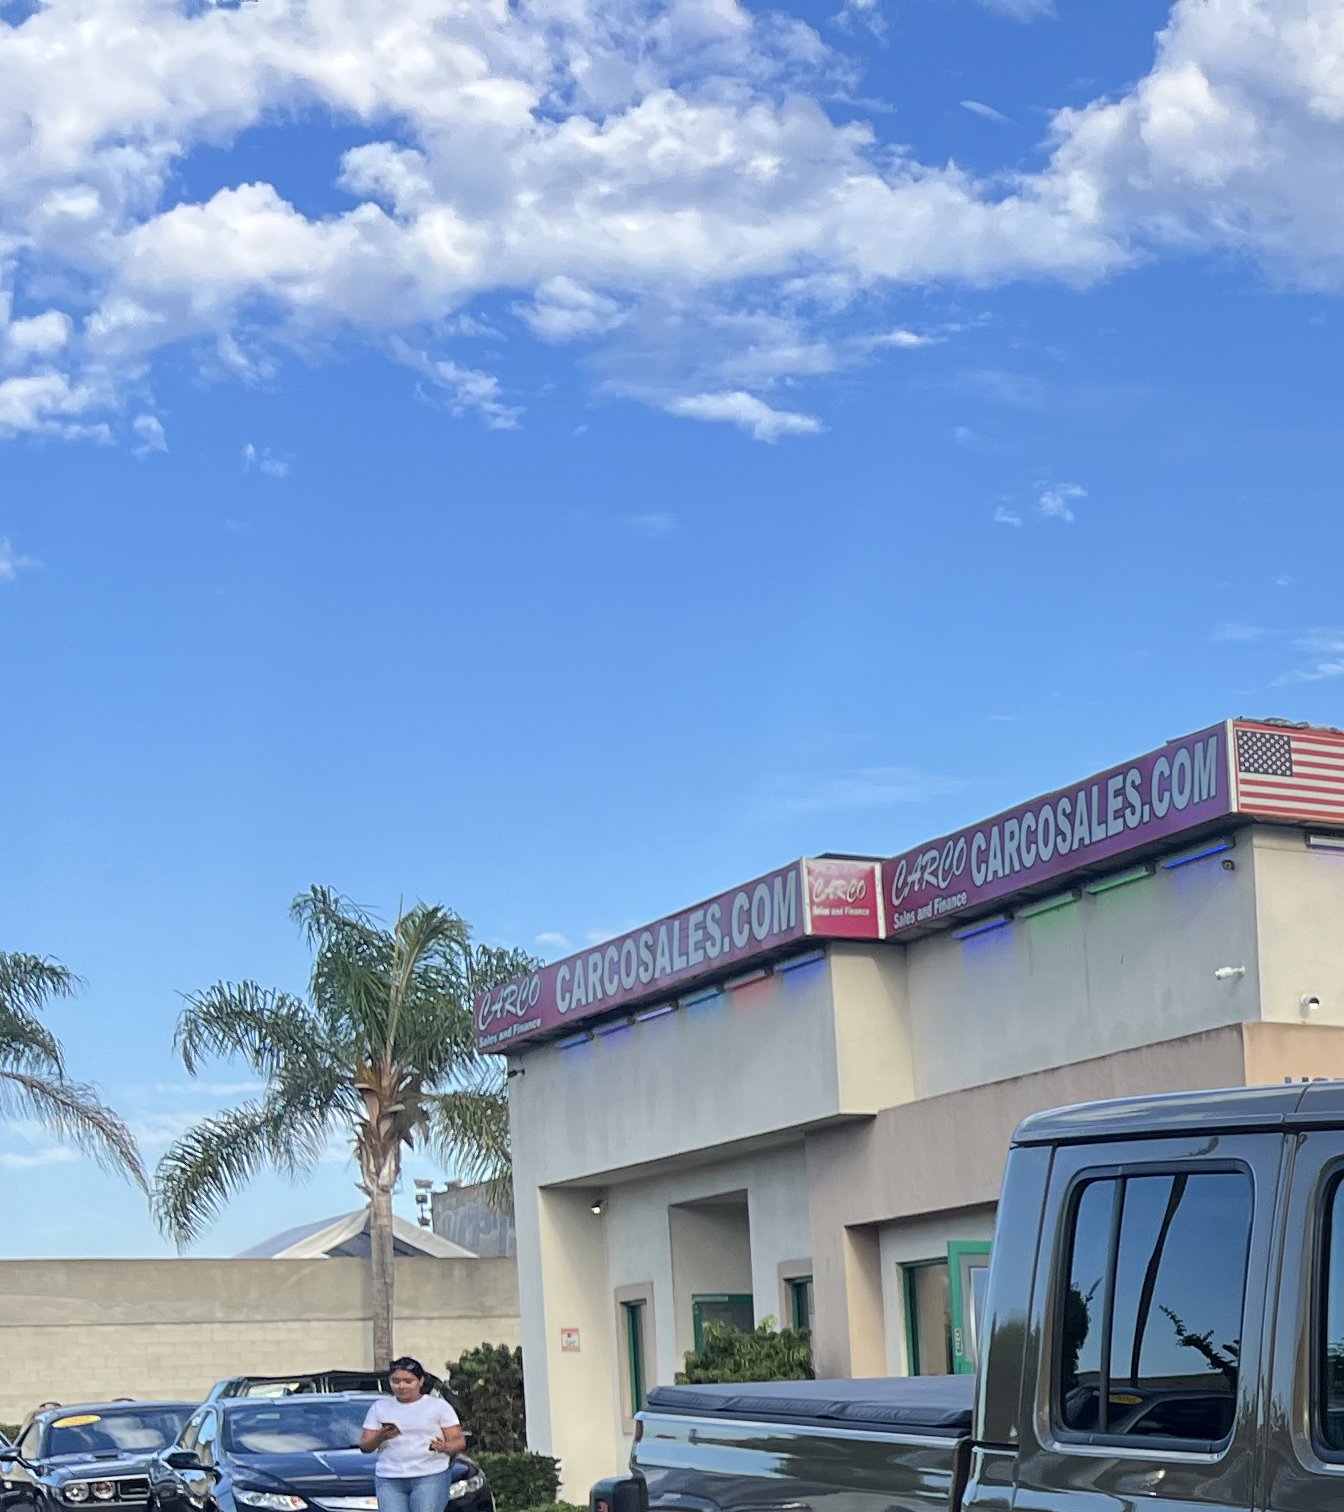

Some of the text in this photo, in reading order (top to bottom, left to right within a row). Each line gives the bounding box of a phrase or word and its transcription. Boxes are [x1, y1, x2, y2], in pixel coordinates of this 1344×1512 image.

[892, 735, 1218, 907] CARCO CARCOSALES.COM
[811, 879, 867, 903] CARCO
[893, 891, 967, 930] Sales and Finance
[478, 870, 797, 1031] CARCO CARCOSALES.COM
